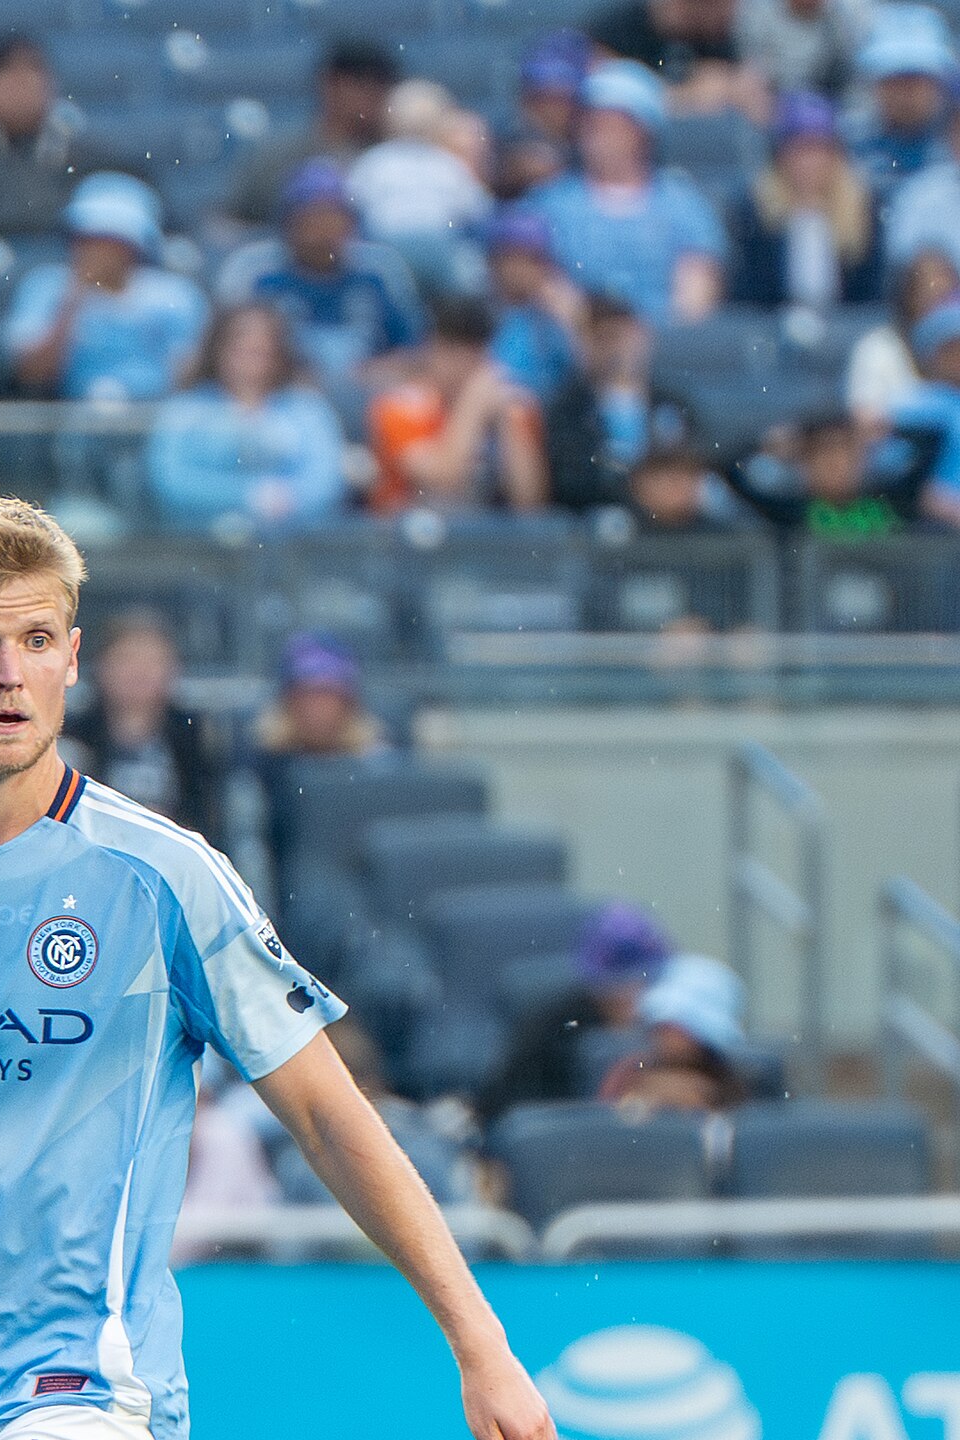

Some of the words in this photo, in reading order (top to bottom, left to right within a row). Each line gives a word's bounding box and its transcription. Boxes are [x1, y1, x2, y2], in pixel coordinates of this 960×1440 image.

[35, 925, 51, 943] NEW
[55, 921, 81, 931] YORK
[81, 930, 95, 948] CITY
[33, 954, 74, 983] FOOTBALL
[74, 957, 92, 978] CLUB
